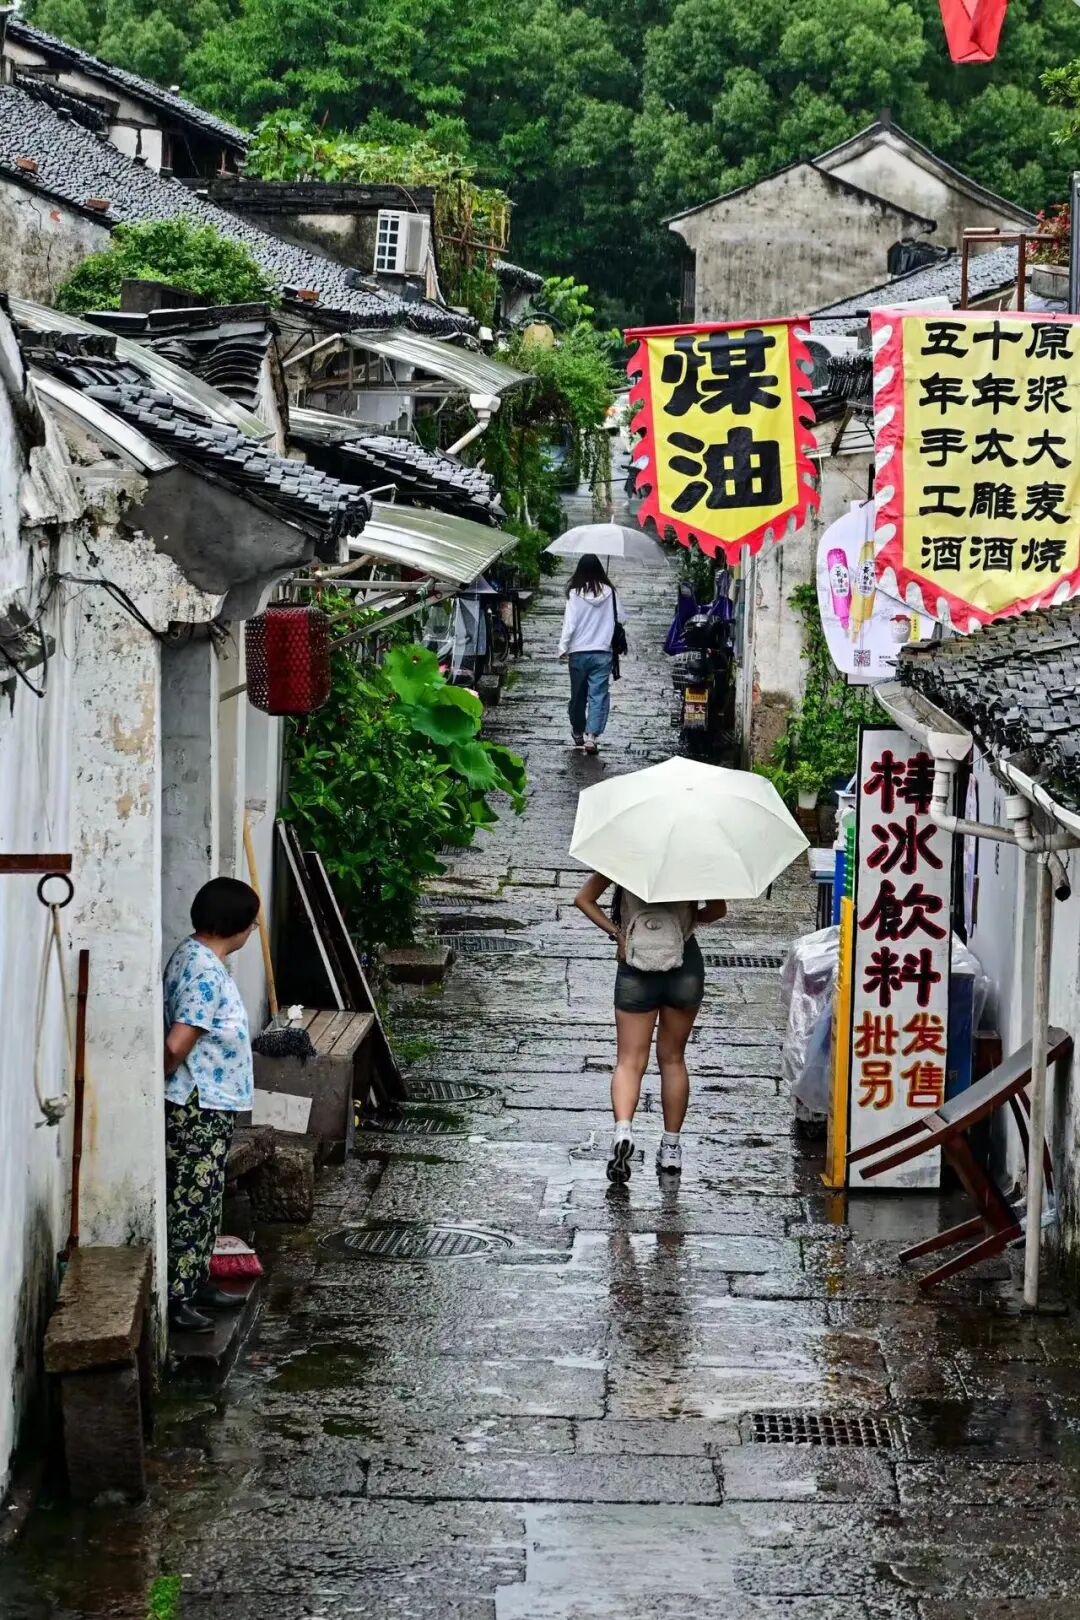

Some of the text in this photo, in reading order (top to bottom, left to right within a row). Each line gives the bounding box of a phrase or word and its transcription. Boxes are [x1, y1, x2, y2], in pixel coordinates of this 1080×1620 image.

[661, 329, 782, 513] 煤油
[919, 321, 969, 572] 五年手工酒
[969, 320, 1023, 572] 十年太雕酒
[1021, 322, 1074, 573] 原浆大麦烧
